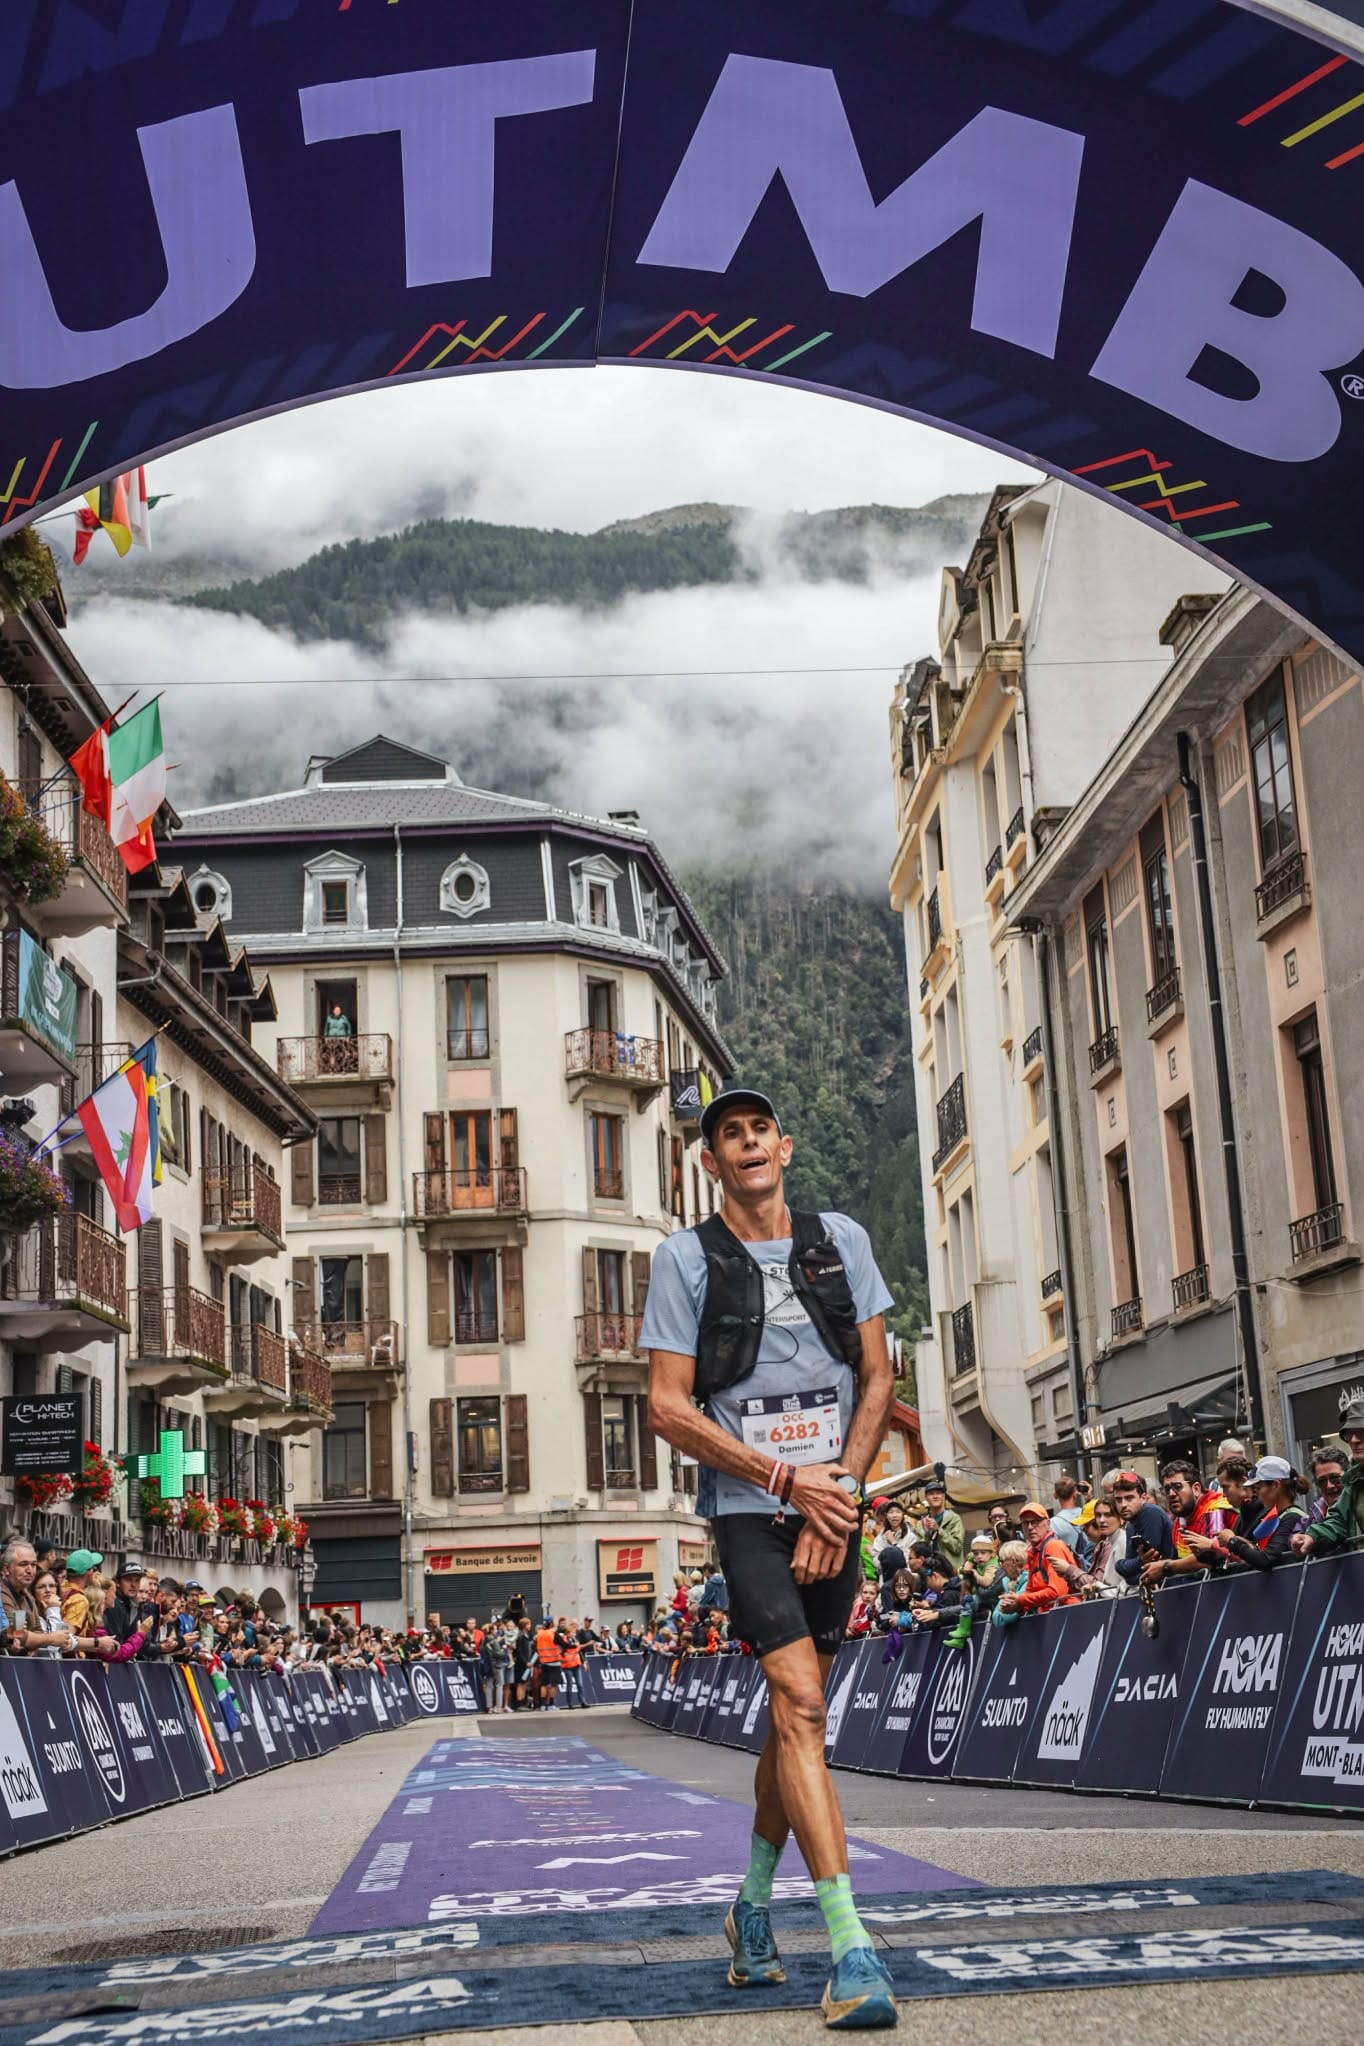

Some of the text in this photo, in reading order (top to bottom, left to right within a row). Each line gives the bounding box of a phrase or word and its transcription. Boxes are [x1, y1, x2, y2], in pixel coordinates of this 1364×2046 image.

[23, 1402, 75, 1413] PLANET
[38, 1411, 75, 1420] HI-TECH
[782, 1412, 805, 1423] OCC
[769, 1421, 820, 1443] 6282
[779, 1442, 815, 1454] Damien
[455, 1553, 538, 1567] Banque de Savoie
[600, 1667, 634, 1681] UTMB
[1212, 1633, 1284, 1694] HOKA
[1114, 1672, 1178, 1703] DACIA
[854, 1692, 879, 1709] DACIA
[982, 1696, 1028, 1727] SUUNTO
[1045, 1701, 1085, 1746] näak
[1205, 1707, 1273, 1729] FLY HUMAN FLY
[44, 1740, 82, 1774] SUUNTO
[24, 1977, 473, 2046] HOKA
